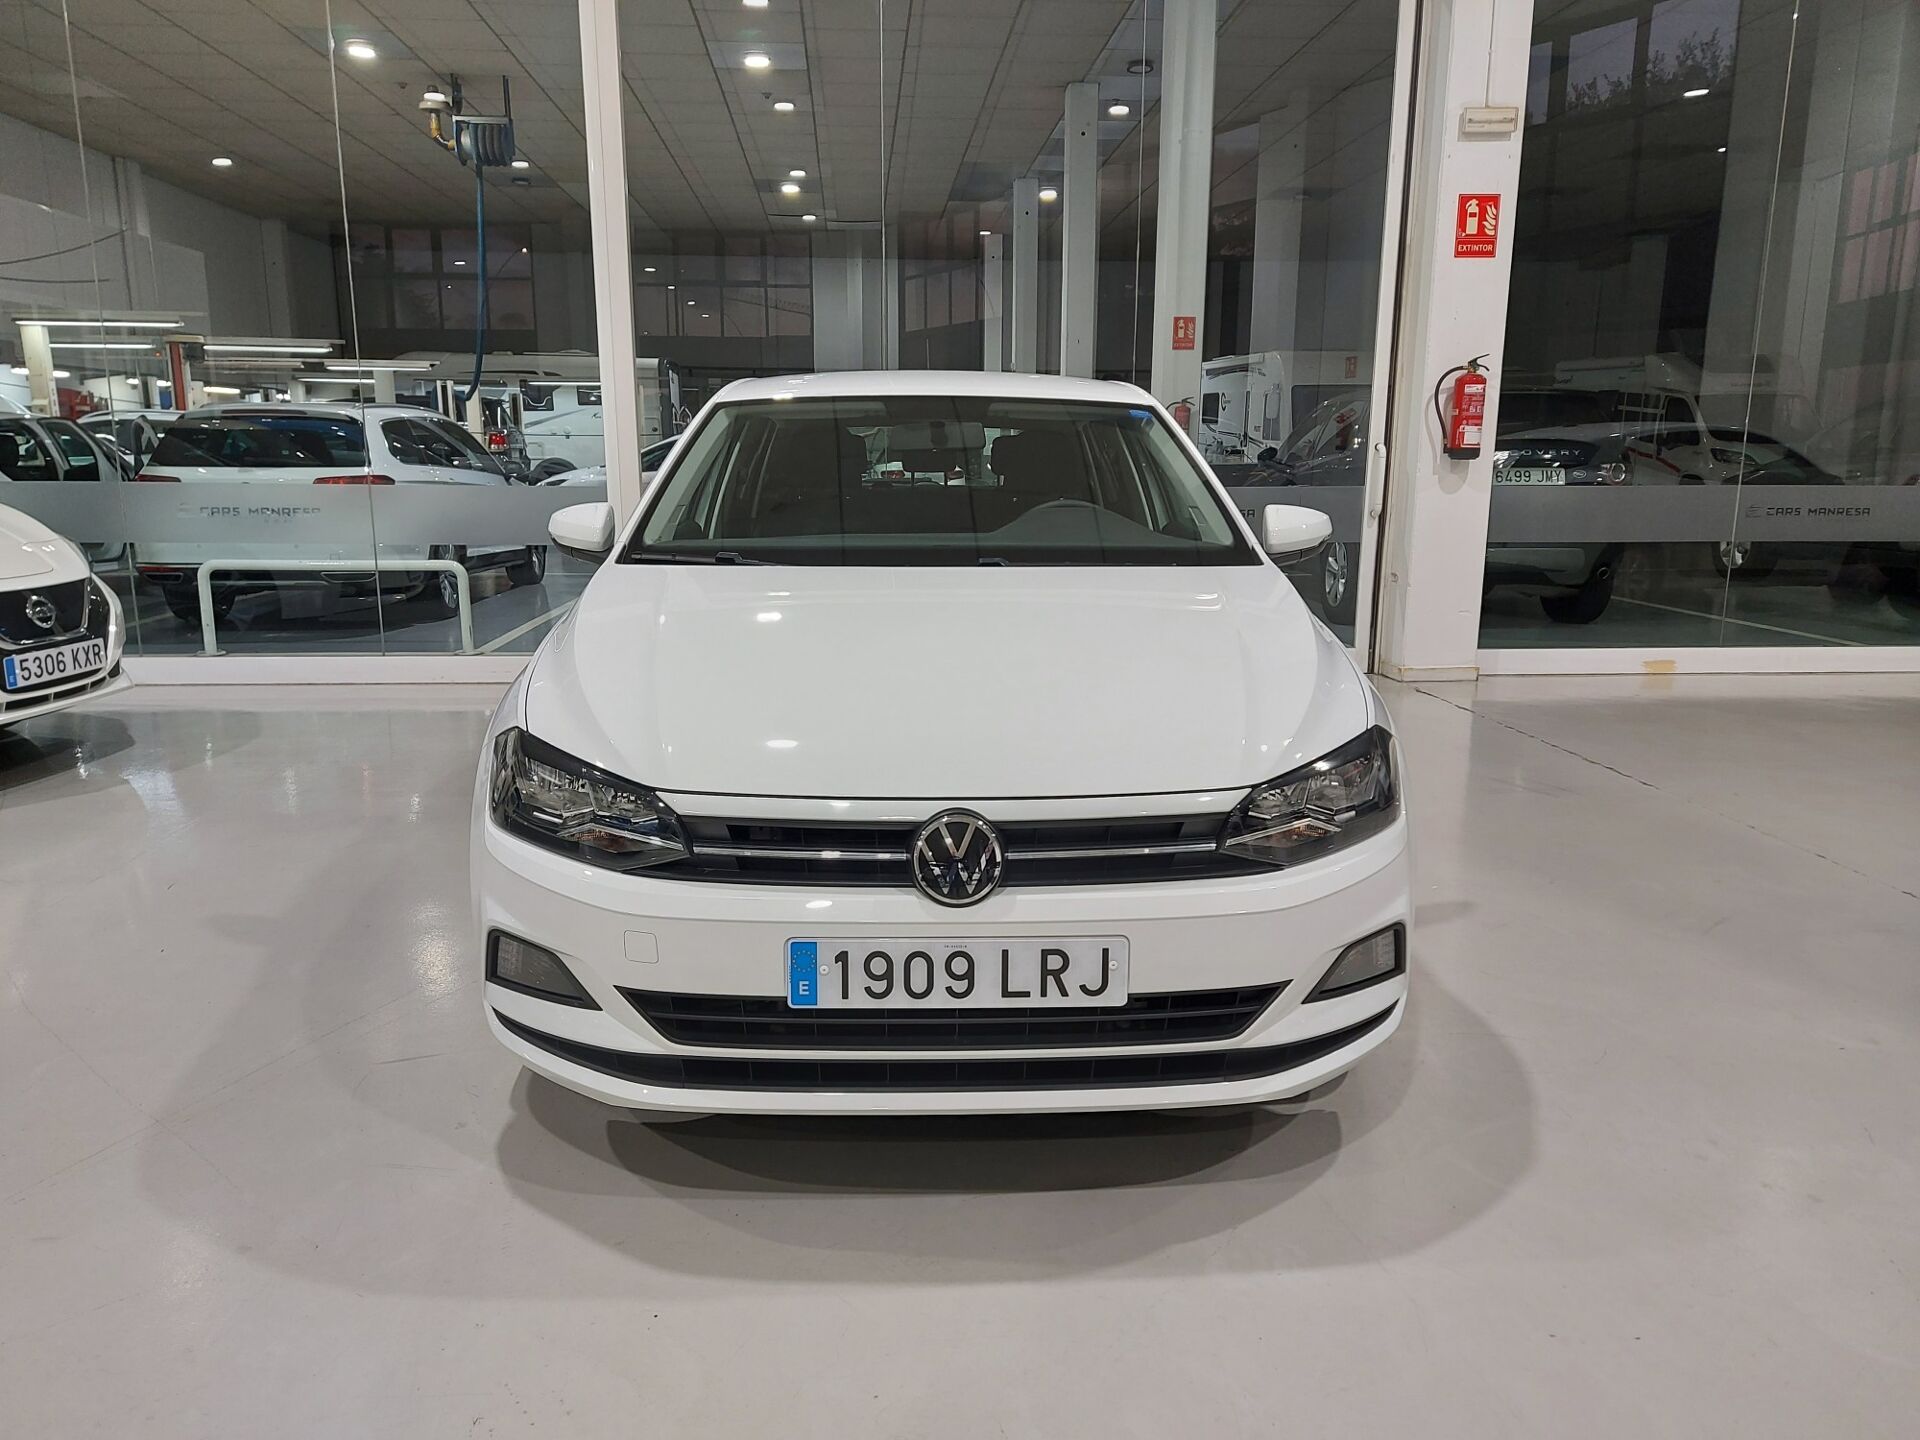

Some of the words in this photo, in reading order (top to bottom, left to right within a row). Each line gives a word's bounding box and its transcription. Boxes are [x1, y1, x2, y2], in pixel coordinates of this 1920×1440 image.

[1458, 244, 1494, 252] EXTINTOR
[1495, 470, 1531, 483] 6499
[1766, 507, 1802, 516] CARS
[1807, 507, 1871, 516] MANRESA
[20, 651, 67, 681] 5306
[71, 643, 103, 670] KXR
[834, 950, 976, 1000] 1909
[1000, 947, 1110, 1000] LRJ
[799, 980, 810, 995] E
